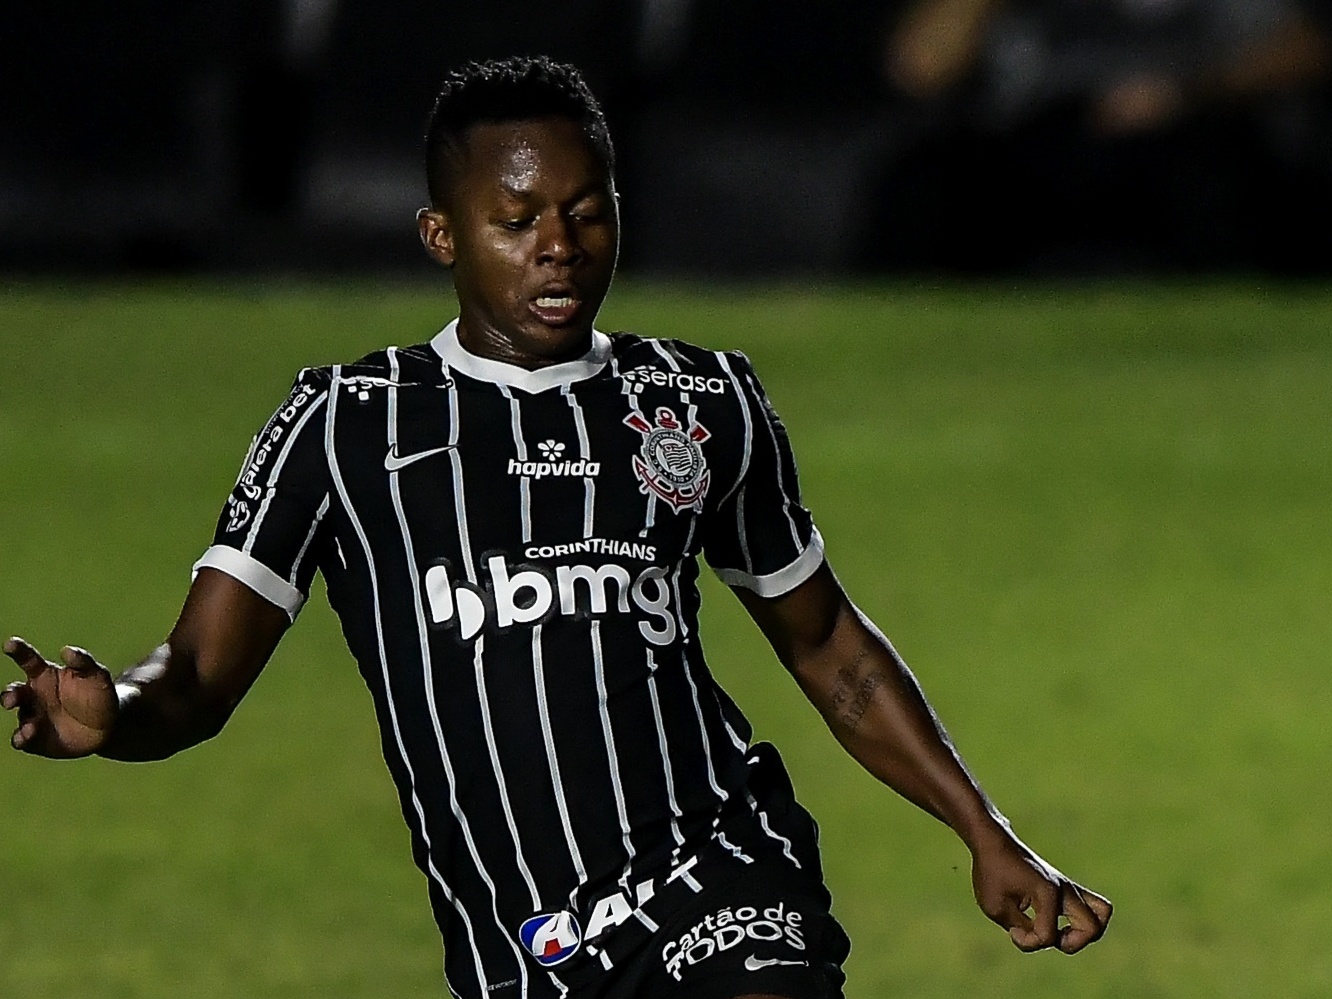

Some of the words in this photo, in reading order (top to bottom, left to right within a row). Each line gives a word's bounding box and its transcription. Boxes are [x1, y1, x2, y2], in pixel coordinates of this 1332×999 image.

[639, 370, 725, 394] serasa
[240, 425, 284, 500] galera
[280, 383, 316, 423] bet
[507, 459, 601, 479] hapvida
[524, 538, 657, 562] CORINTHIANS
[488, 555, 677, 646] bmg
[662, 906, 757, 962] Cartão
[763, 901, 803, 928] de
[665, 920, 806, 982] TODOS
